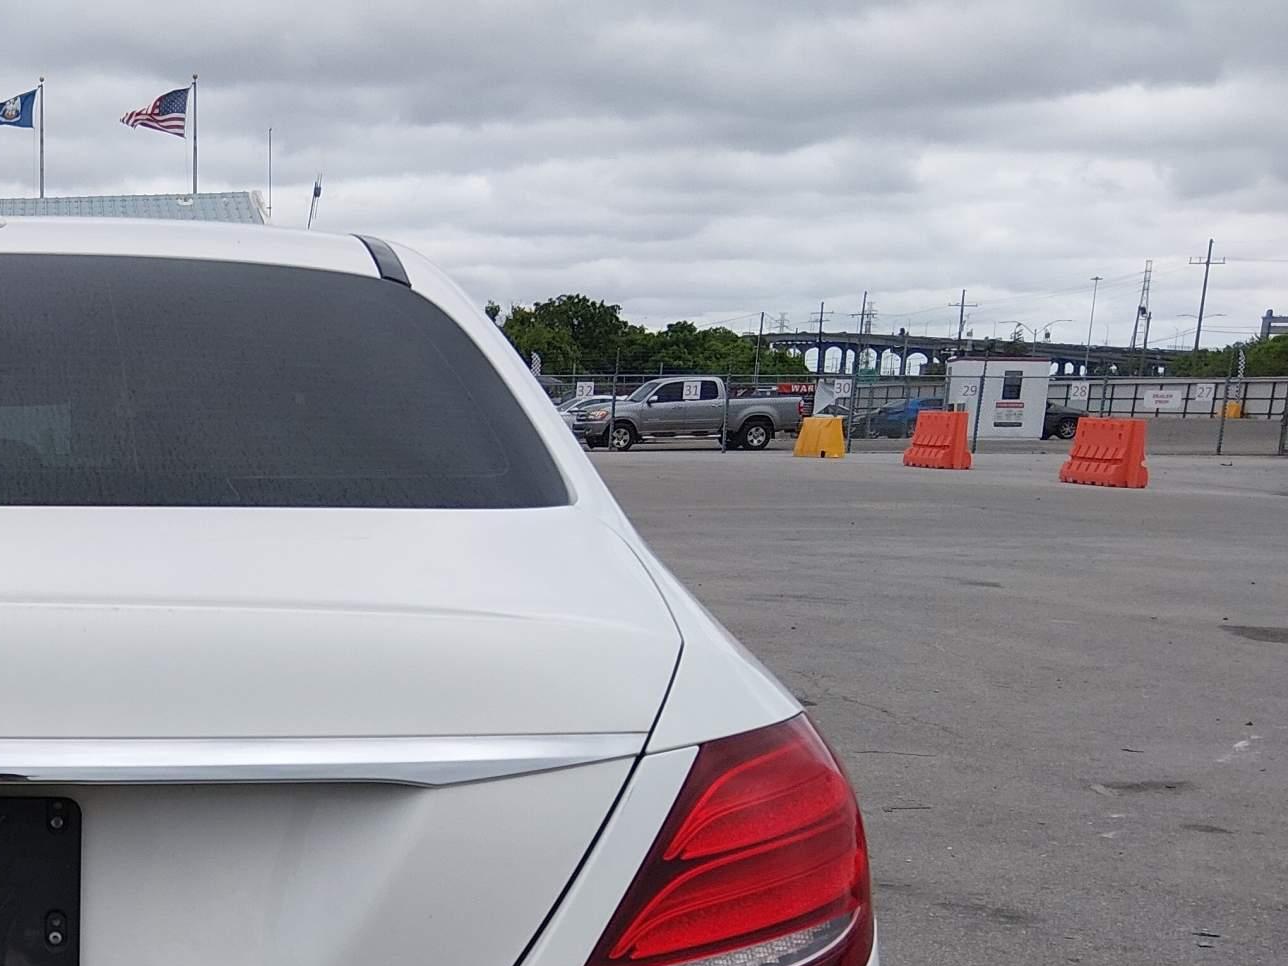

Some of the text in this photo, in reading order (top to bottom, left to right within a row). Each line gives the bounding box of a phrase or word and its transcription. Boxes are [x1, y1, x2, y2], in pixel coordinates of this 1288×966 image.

[577, 385, 593, 397] 32
[684, 385, 699, 397] 31
[835, 382, 851, 394] 30
[962, 385, 978, 397] 29
[1072, 385, 1088, 398] 28
[1196, 386, 1213, 398] 27
